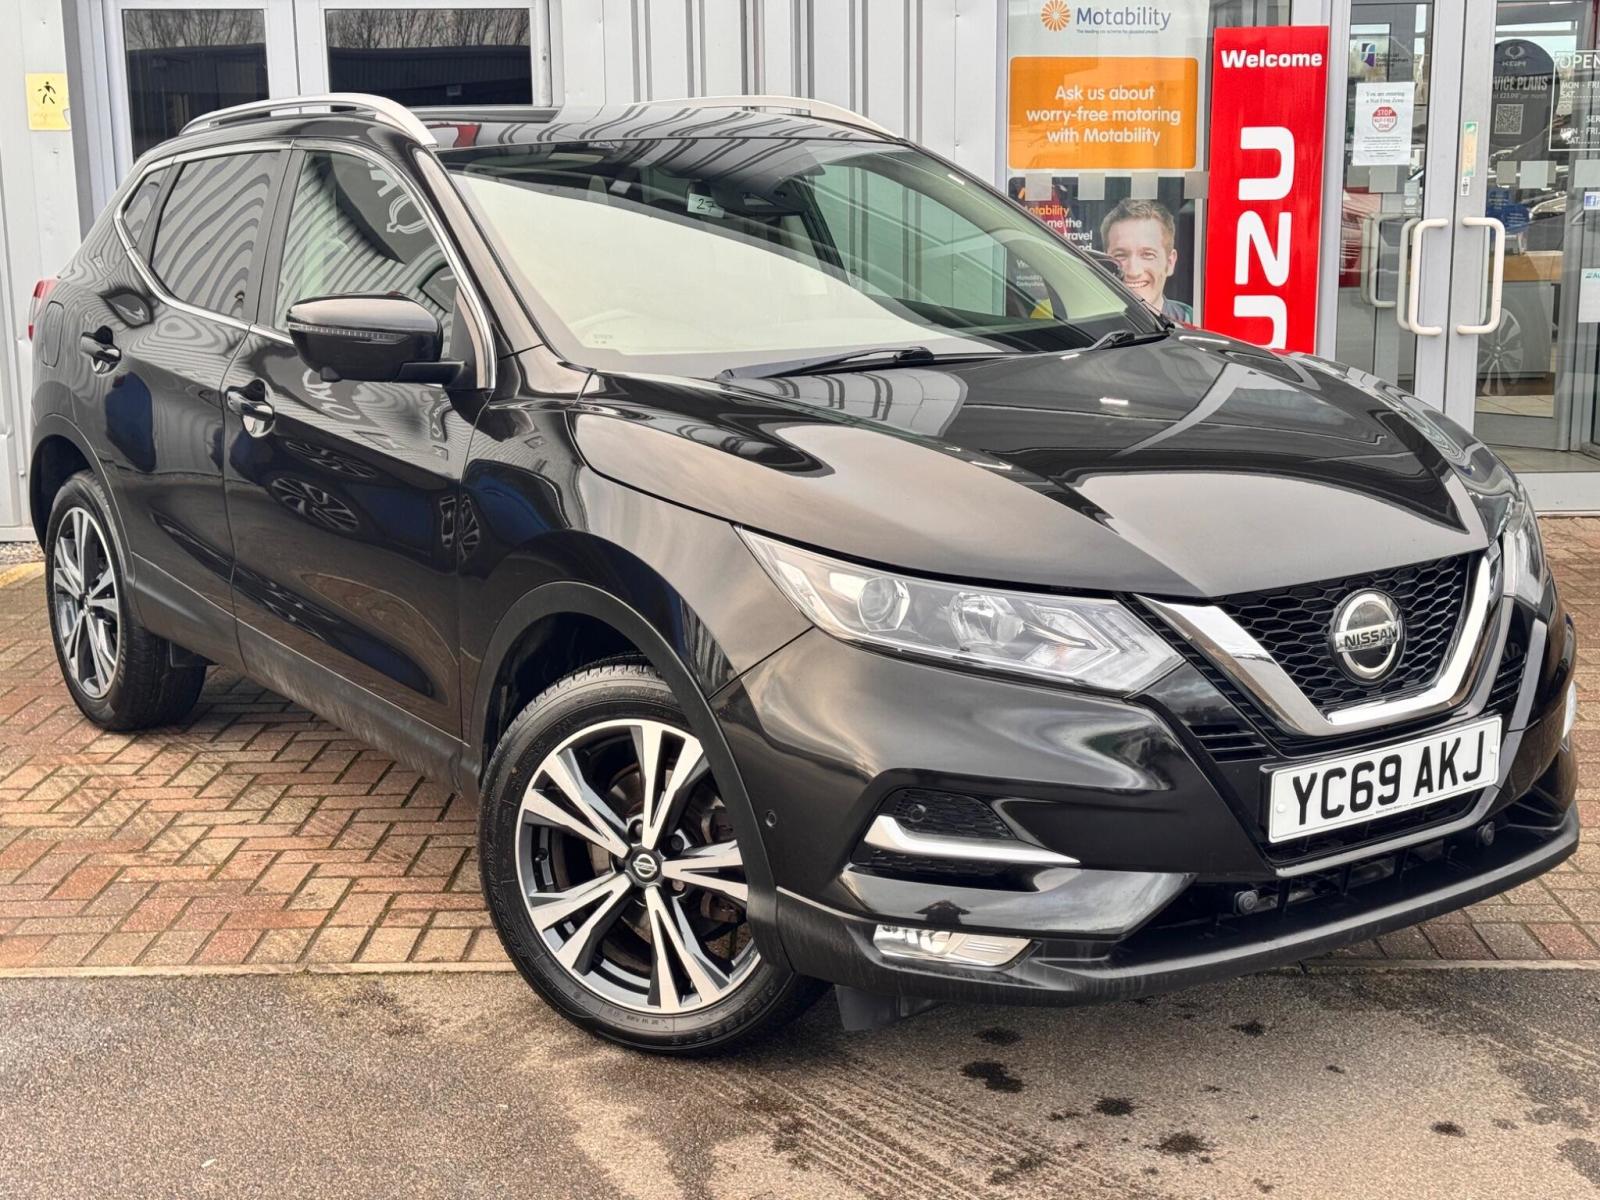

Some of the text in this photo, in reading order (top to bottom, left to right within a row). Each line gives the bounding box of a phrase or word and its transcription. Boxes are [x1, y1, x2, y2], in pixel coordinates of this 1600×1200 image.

[1076, 6, 1171, 31] Motability
[1221, 49, 1323, 68] Welcome
[1055, 85, 1155, 100] Ask us about
[1516, 75, 1548, 91] PLANS
[1561, 81, 1579, 89] MON
[1026, 106, 1181, 126] worry-free motoring
[1047, 127, 1161, 146] with Motability
[1025, 204, 1070, 217] otability
[1065, 217, 1082, 228] the
[1344, 626, 1398, 648] NISSAN
[1292, 730, 1485, 826] YC69 AKJ
